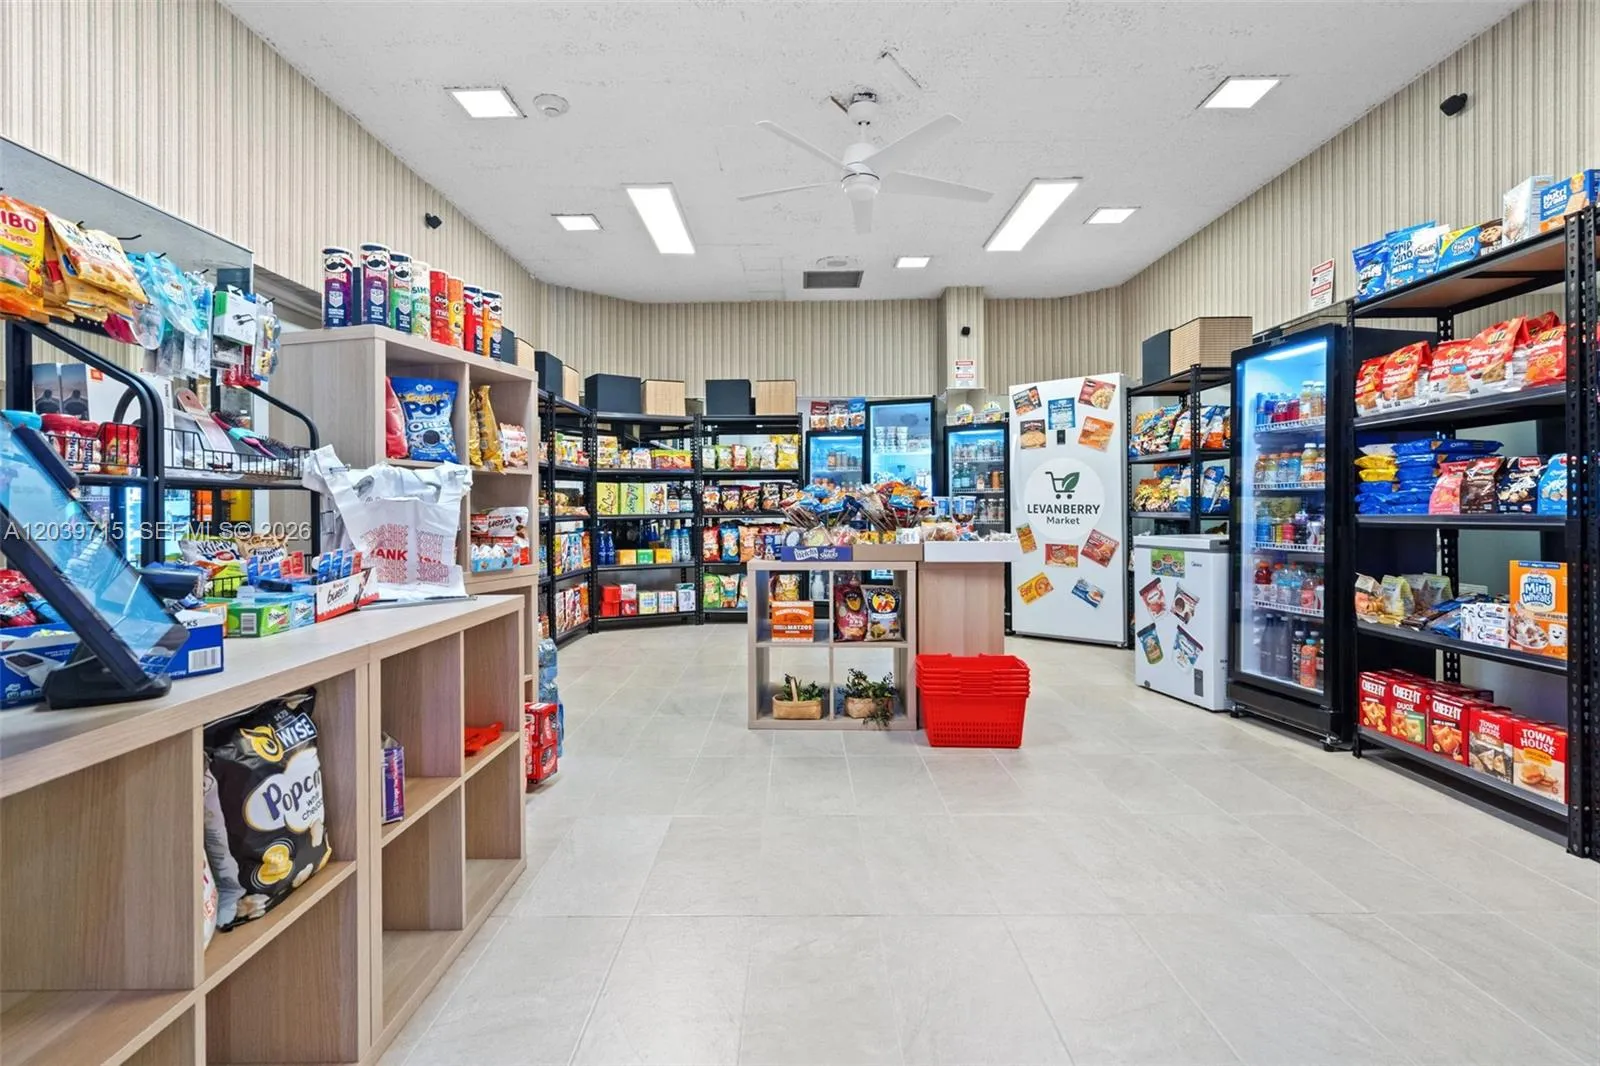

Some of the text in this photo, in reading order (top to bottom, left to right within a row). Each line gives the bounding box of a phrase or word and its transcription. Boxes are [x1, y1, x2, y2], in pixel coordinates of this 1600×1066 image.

[0, 210, 37, 233] IBO
[1027, 504, 1100, 514] LEVANBERRY
[1046, 516, 1080, 525] Market
[1524, 583, 1551, 595] Mini
[277, 718, 314, 748] WISE
[1521, 729, 1554, 745] TOWN
[1520, 738, 1556, 756] HOUSE
